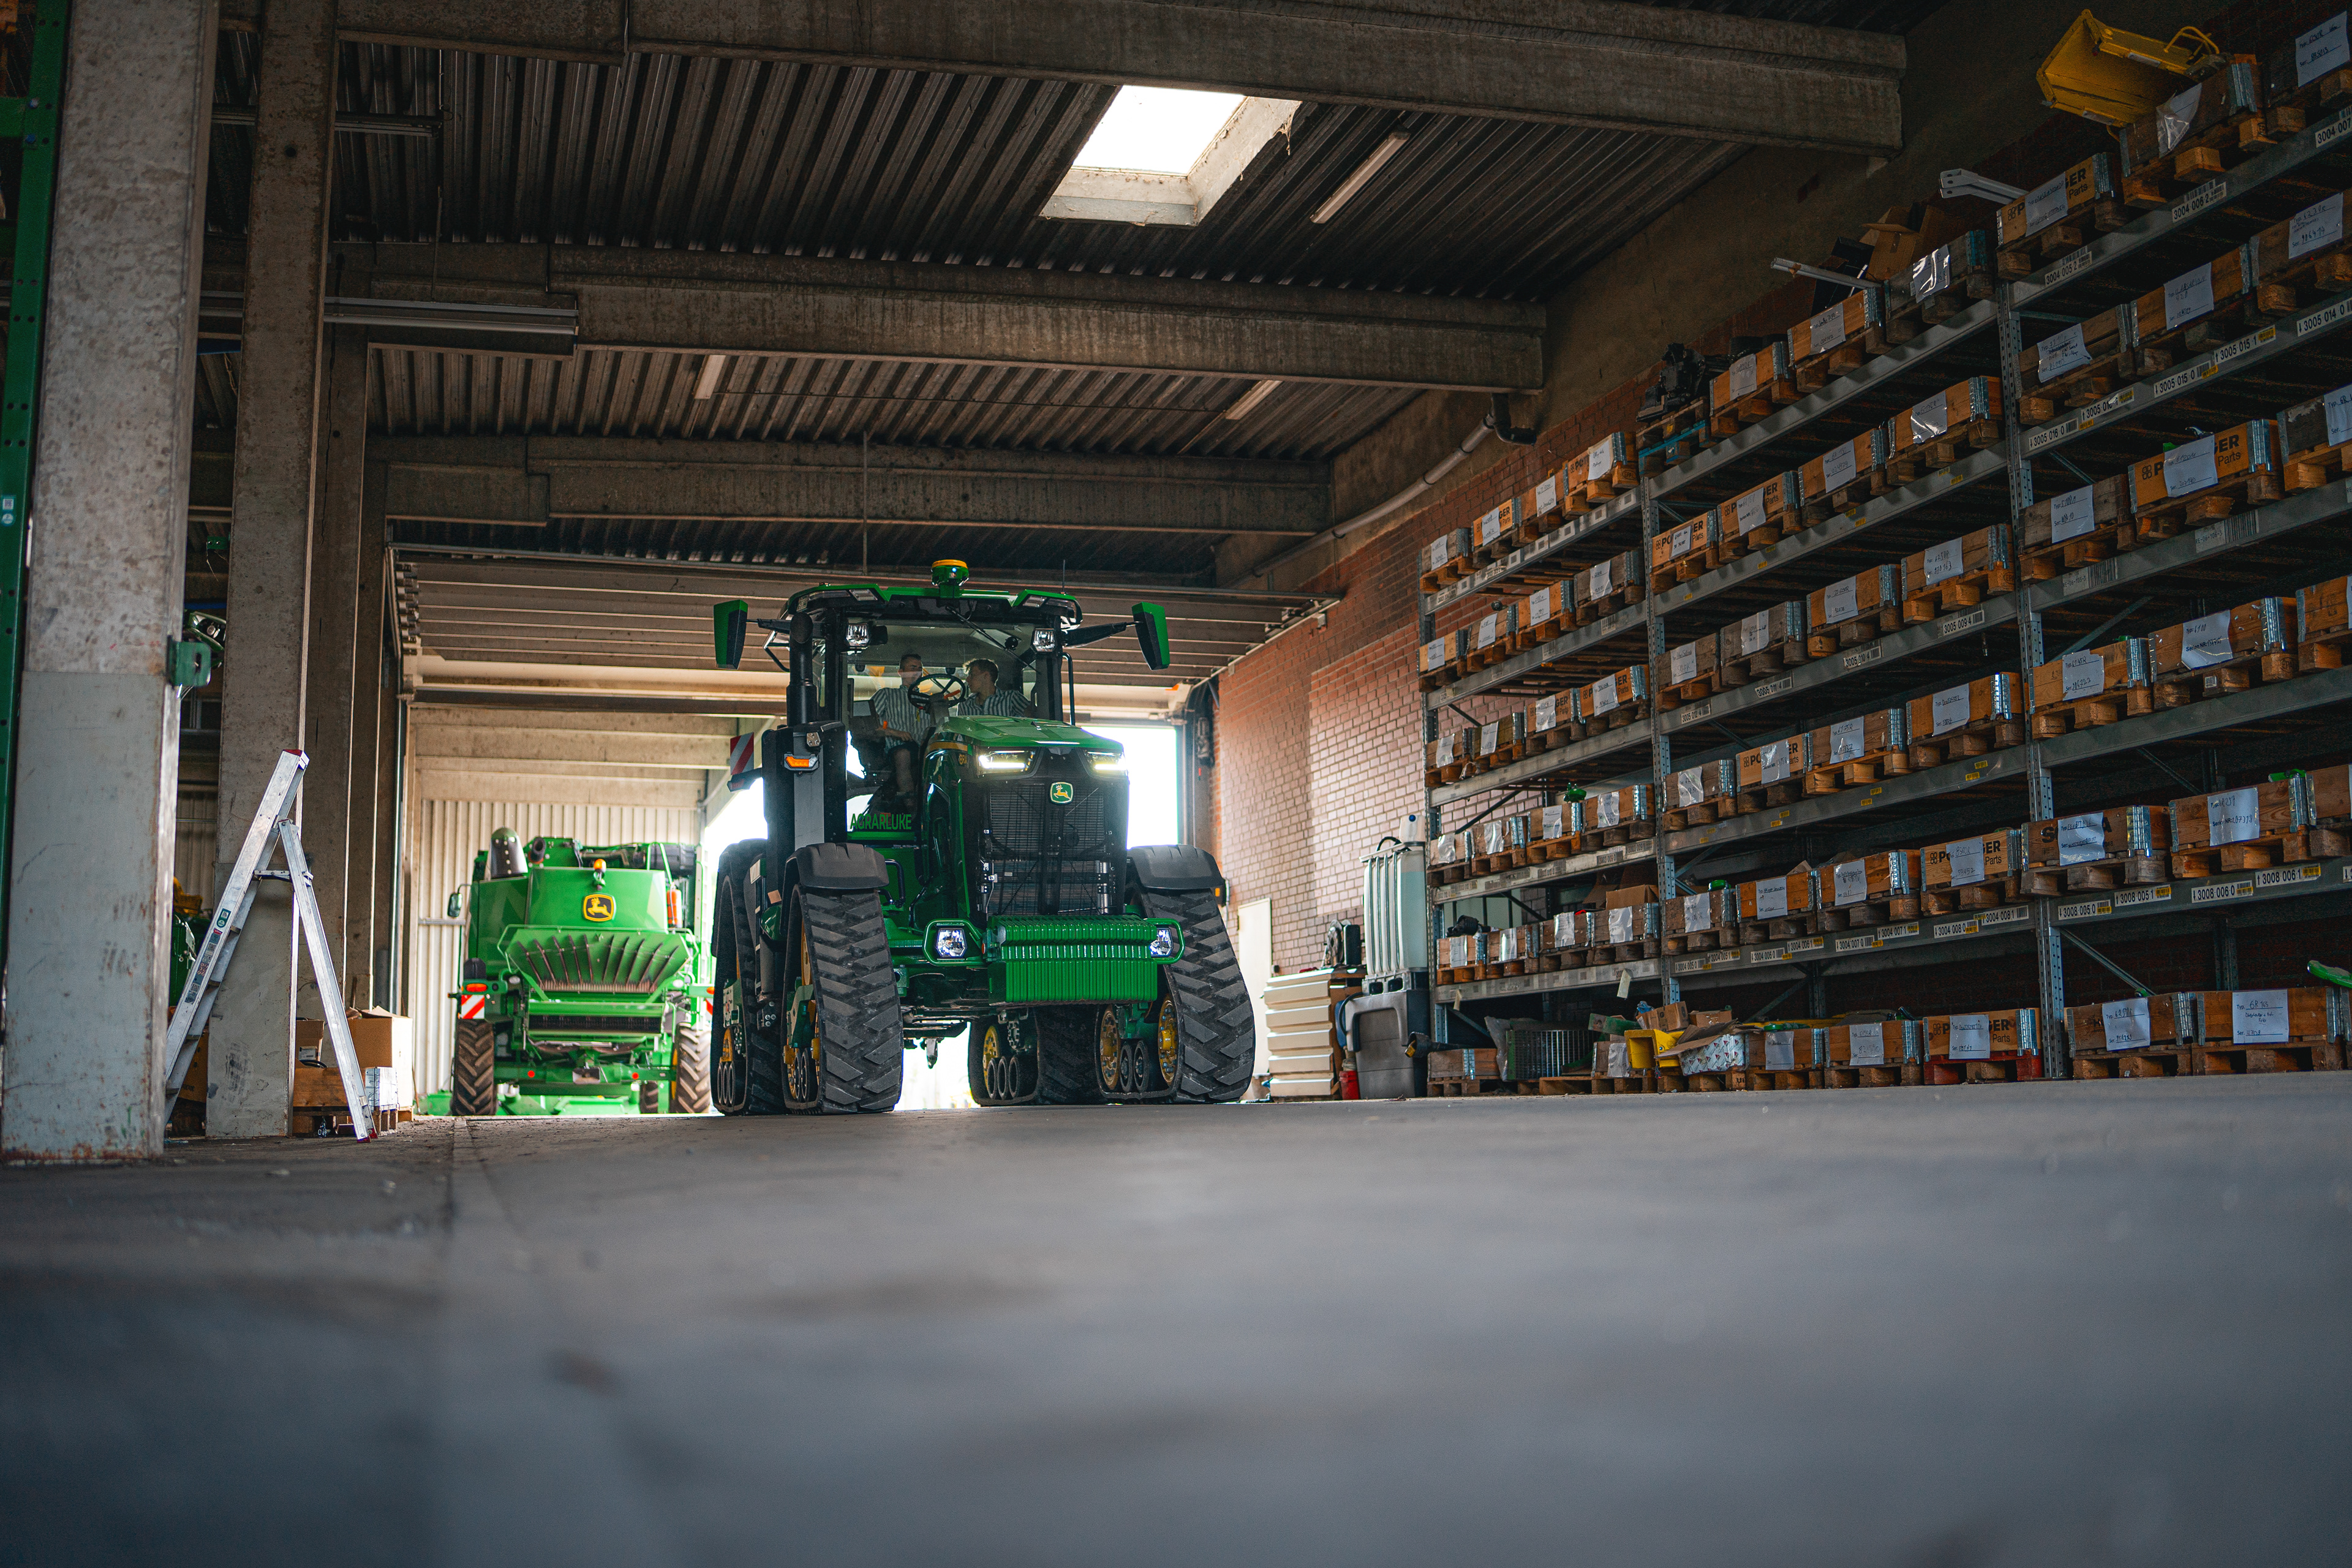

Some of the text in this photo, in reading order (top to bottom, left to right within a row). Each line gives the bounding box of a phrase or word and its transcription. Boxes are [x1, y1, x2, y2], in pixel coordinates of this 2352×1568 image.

[2068, 183, 2088, 200] Parts
[2304, 315, 2321, 331] 3005
[2220, 344, 2236, 360] 3005
[2160, 377, 2175, 393] 3005
[2177, 373, 2188, 386] 015
[2034, 432, 2047, 447] 3005
[2218, 451, 2242, 467] Parts
[1766, 496, 1779, 505] Parts
[1693, 533, 1703, 542] Parts
[1790, 756, 1799, 764] arts
[1985, 856, 2002, 865] Parts
[2263, 873, 2280, 884] 3008
[2283, 870, 2296, 883] 006
[2120, 892, 2135, 904] 3008
[2138, 891, 2149, 901] 005
[2198, 886, 2235, 900] 3008 006 0
[1986, 912, 1999, 923] 3004
[2000, 910, 2011, 921] 008
[2064, 903, 2095, 918] 3008 005 0
[1882, 927, 1893, 938] 3004
[1894, 925, 1902, 935] 007
[1939, 926, 1950, 937] 3004
[1952, 924, 1961, 935] 008
[2250, 1000, 2258, 1009] 6R
[1992, 1034, 2010, 1043] Parts
